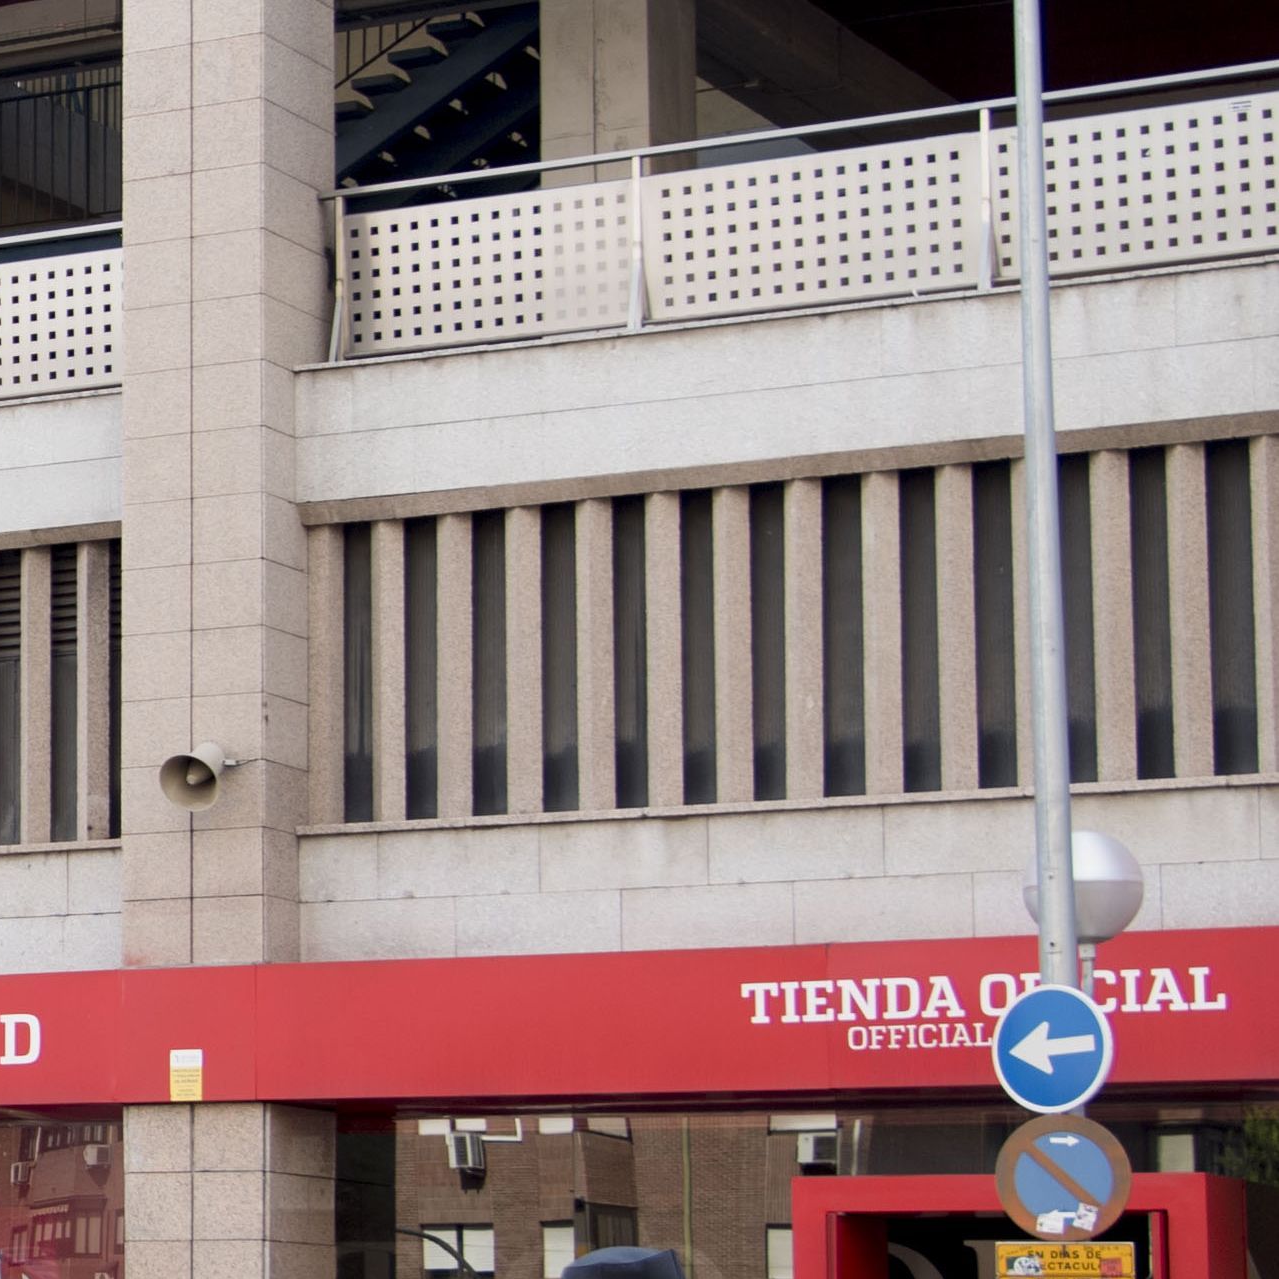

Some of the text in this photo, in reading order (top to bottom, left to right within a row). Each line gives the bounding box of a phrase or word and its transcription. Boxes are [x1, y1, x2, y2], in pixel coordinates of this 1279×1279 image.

[740, 966, 1227, 1024] TIENDA OCIAL
[847, 1022, 993, 1051] OFFICIAL
[1086, 1250, 1102, 1259] DE
[1040, 1261, 1103, 1271] ECTACUL
